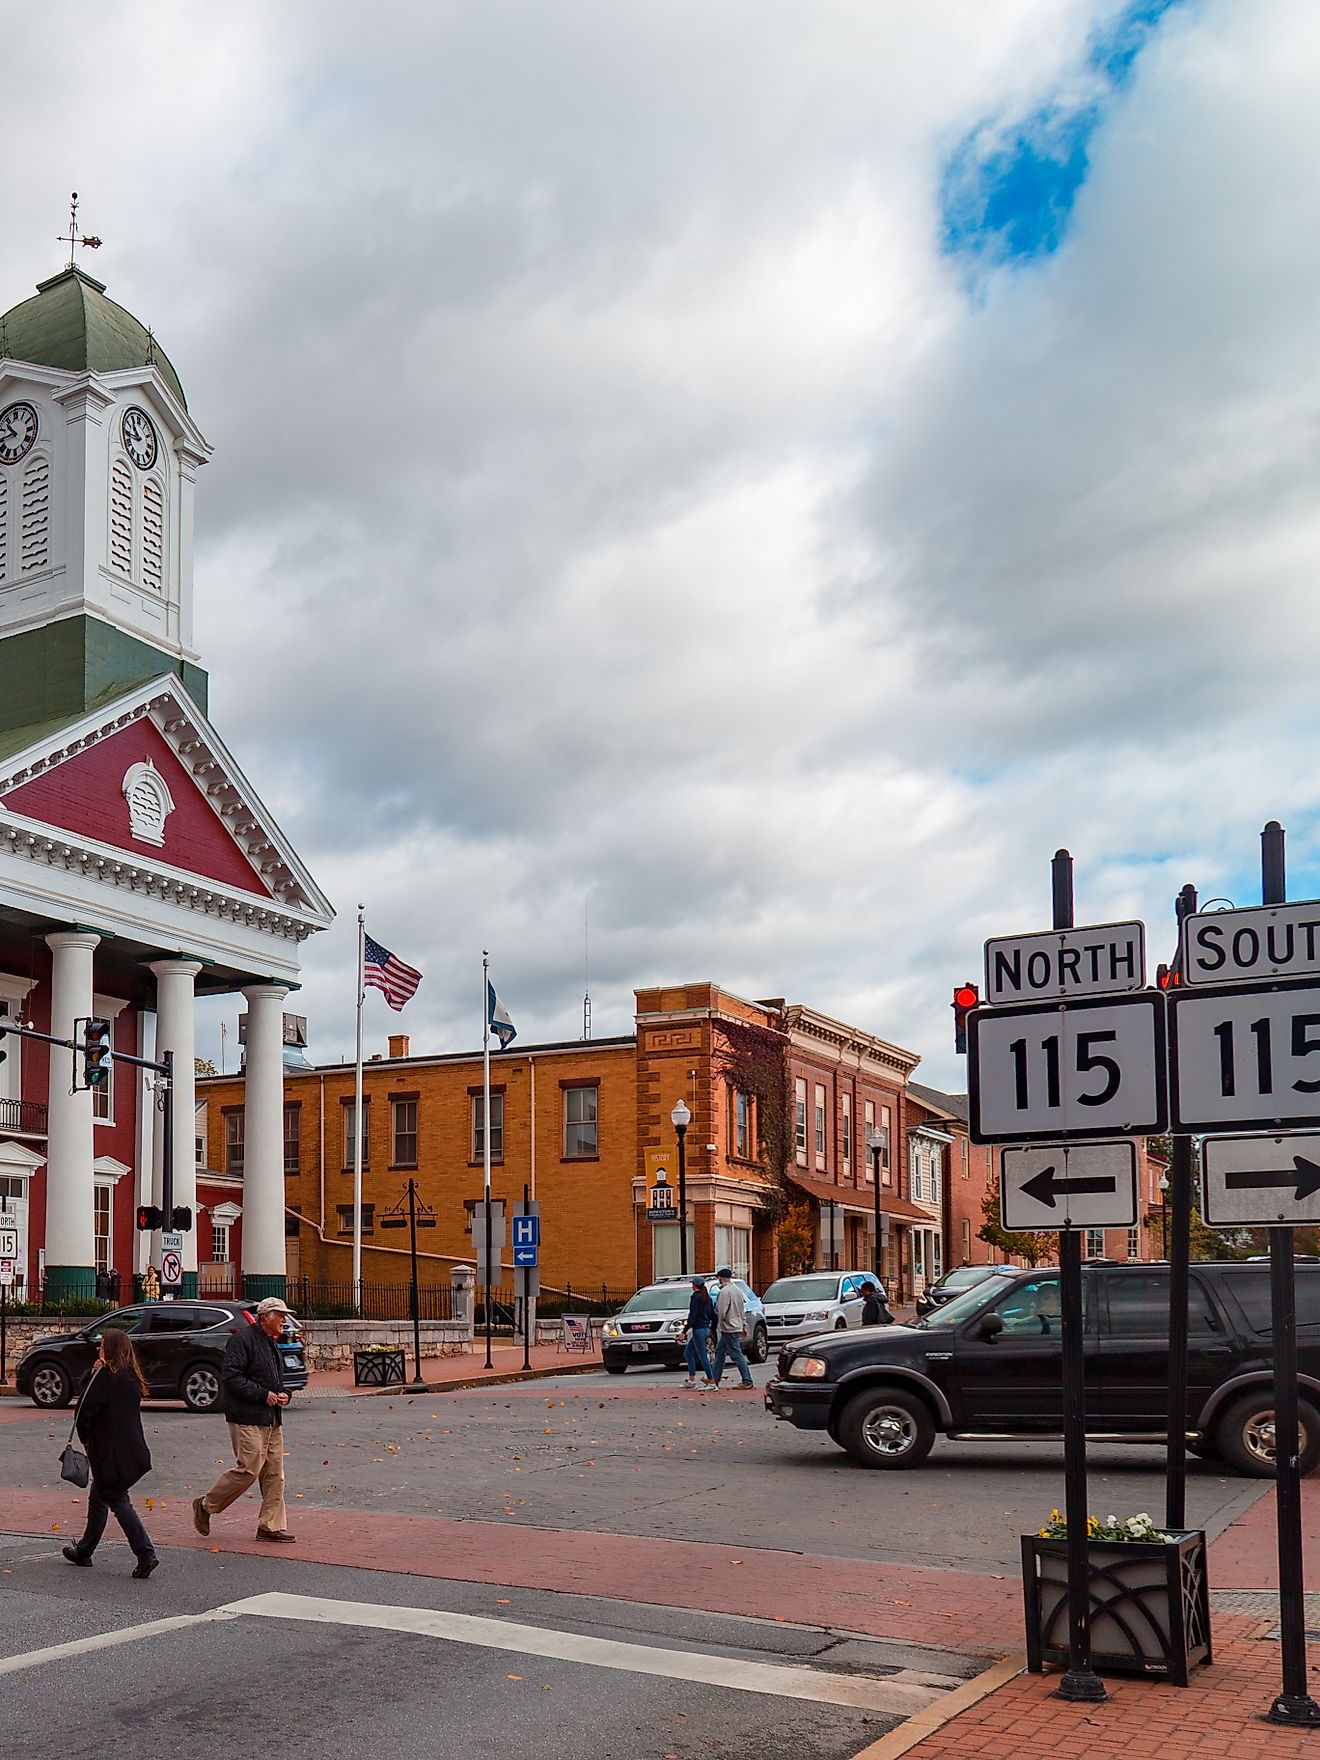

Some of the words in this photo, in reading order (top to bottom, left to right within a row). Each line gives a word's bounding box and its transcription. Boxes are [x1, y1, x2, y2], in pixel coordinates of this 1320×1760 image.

[995, 940, 1135, 993] NORTH
[1009, 1029, 1122, 1111] 115
[1213, 1013, 1320, 1097] 115
[163, 1236, 180, 1246] TRUCK
[517, 1220, 533, 1243] H
[631, 1323, 650, 1331] GMC
